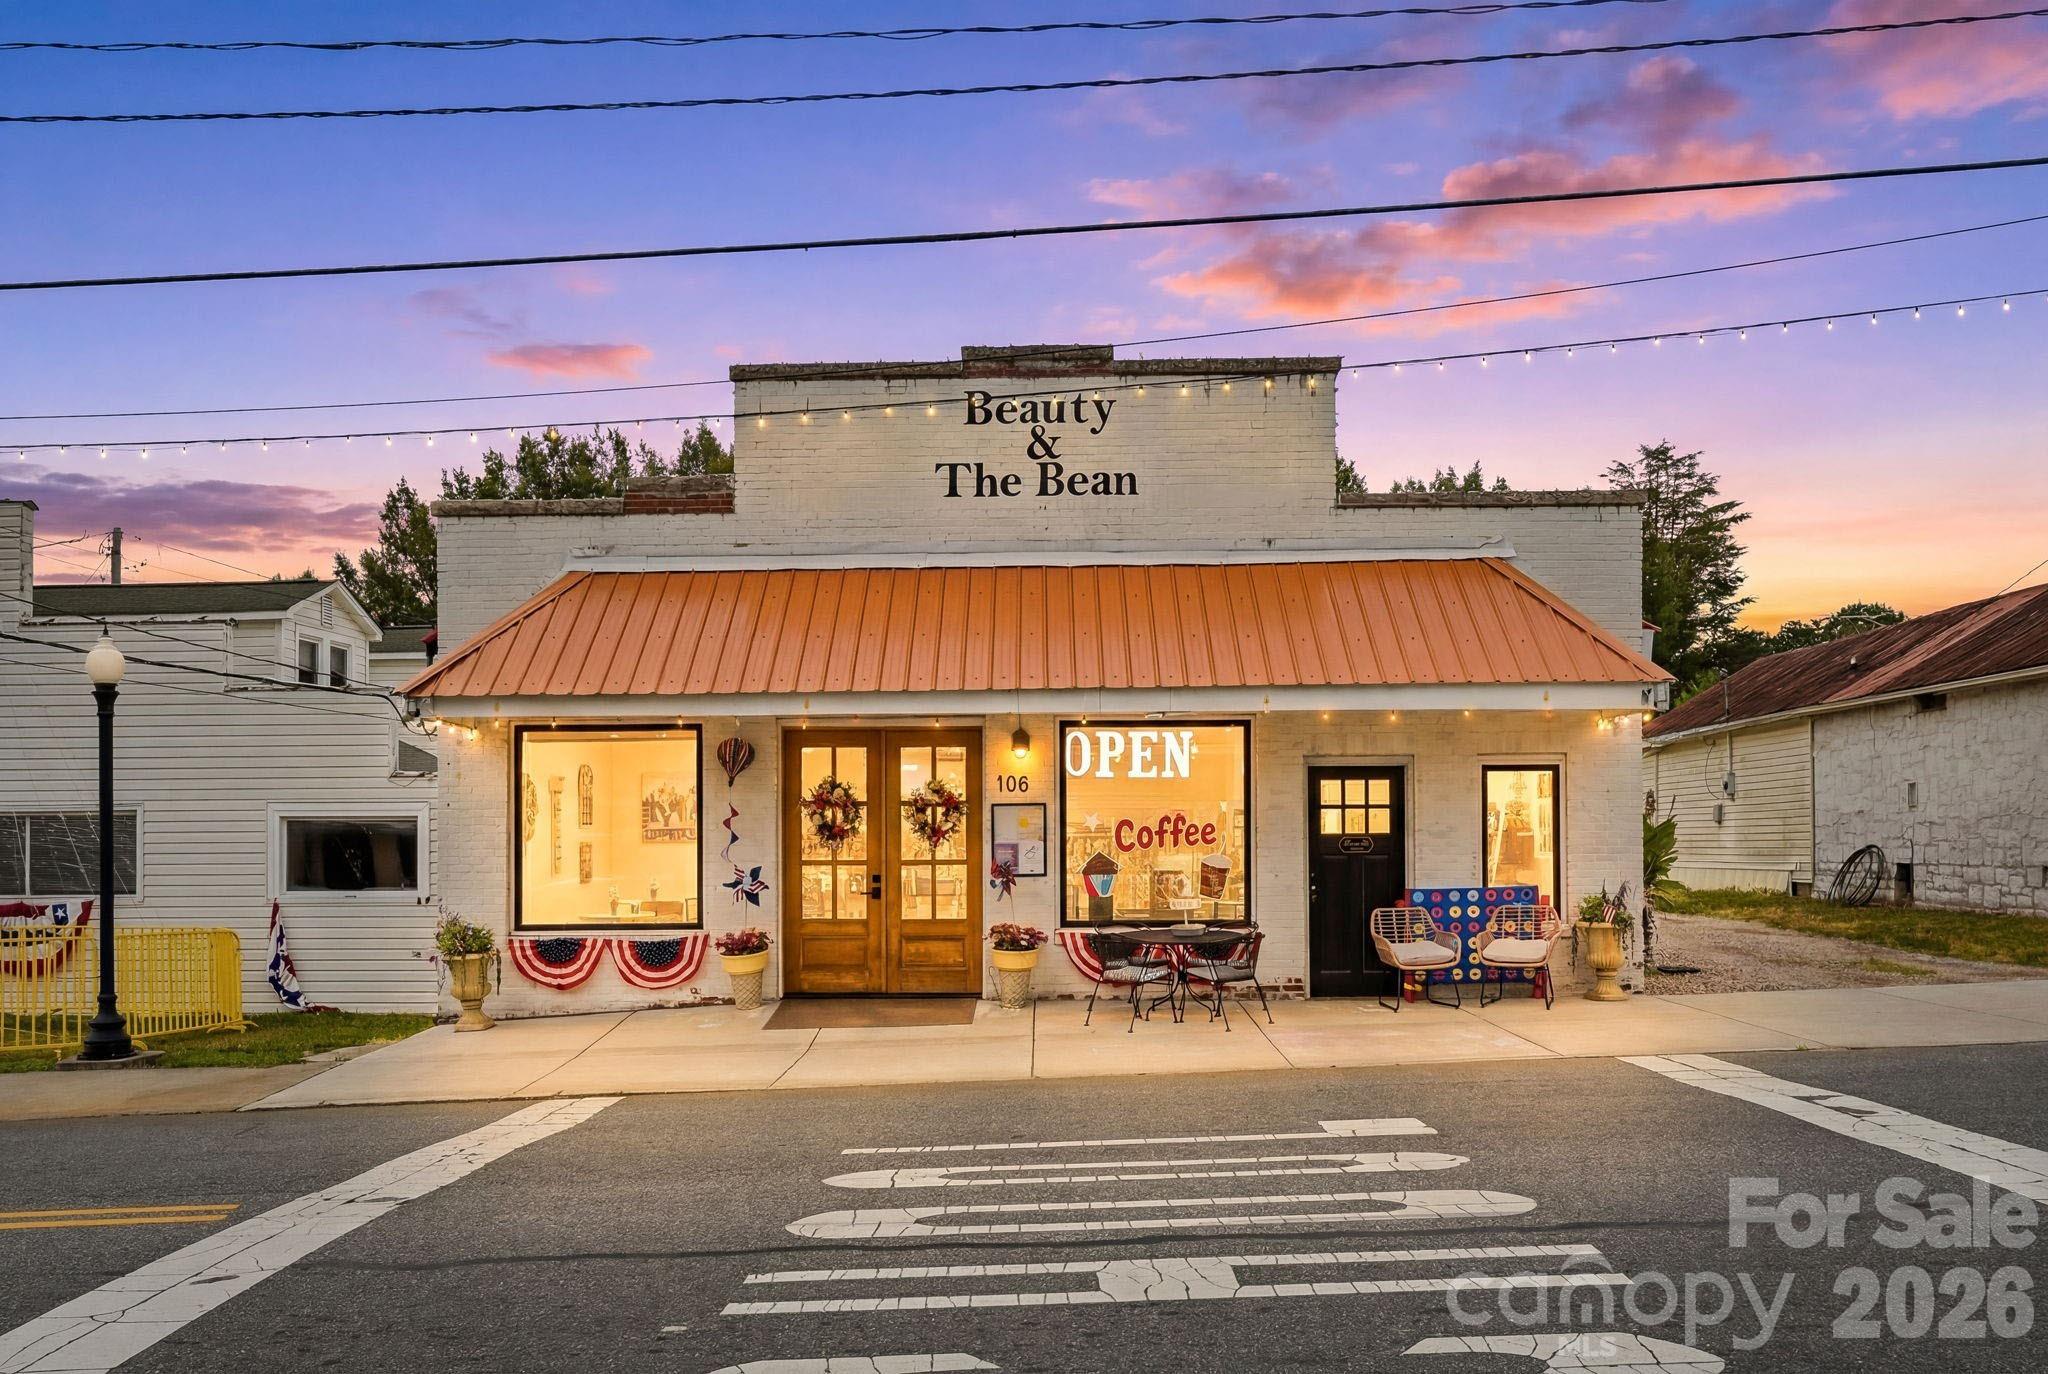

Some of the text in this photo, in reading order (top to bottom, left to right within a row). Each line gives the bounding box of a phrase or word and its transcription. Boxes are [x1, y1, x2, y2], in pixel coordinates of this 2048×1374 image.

[963, 390, 1117, 434] Beauty
[1026, 425, 1062, 460] &
[935, 461, 1139, 498] The Bean
[1065, 730, 1194, 778] OPEN
[996, 775, 1029, 793] 106
[1114, 813, 1217, 853] Coffee
